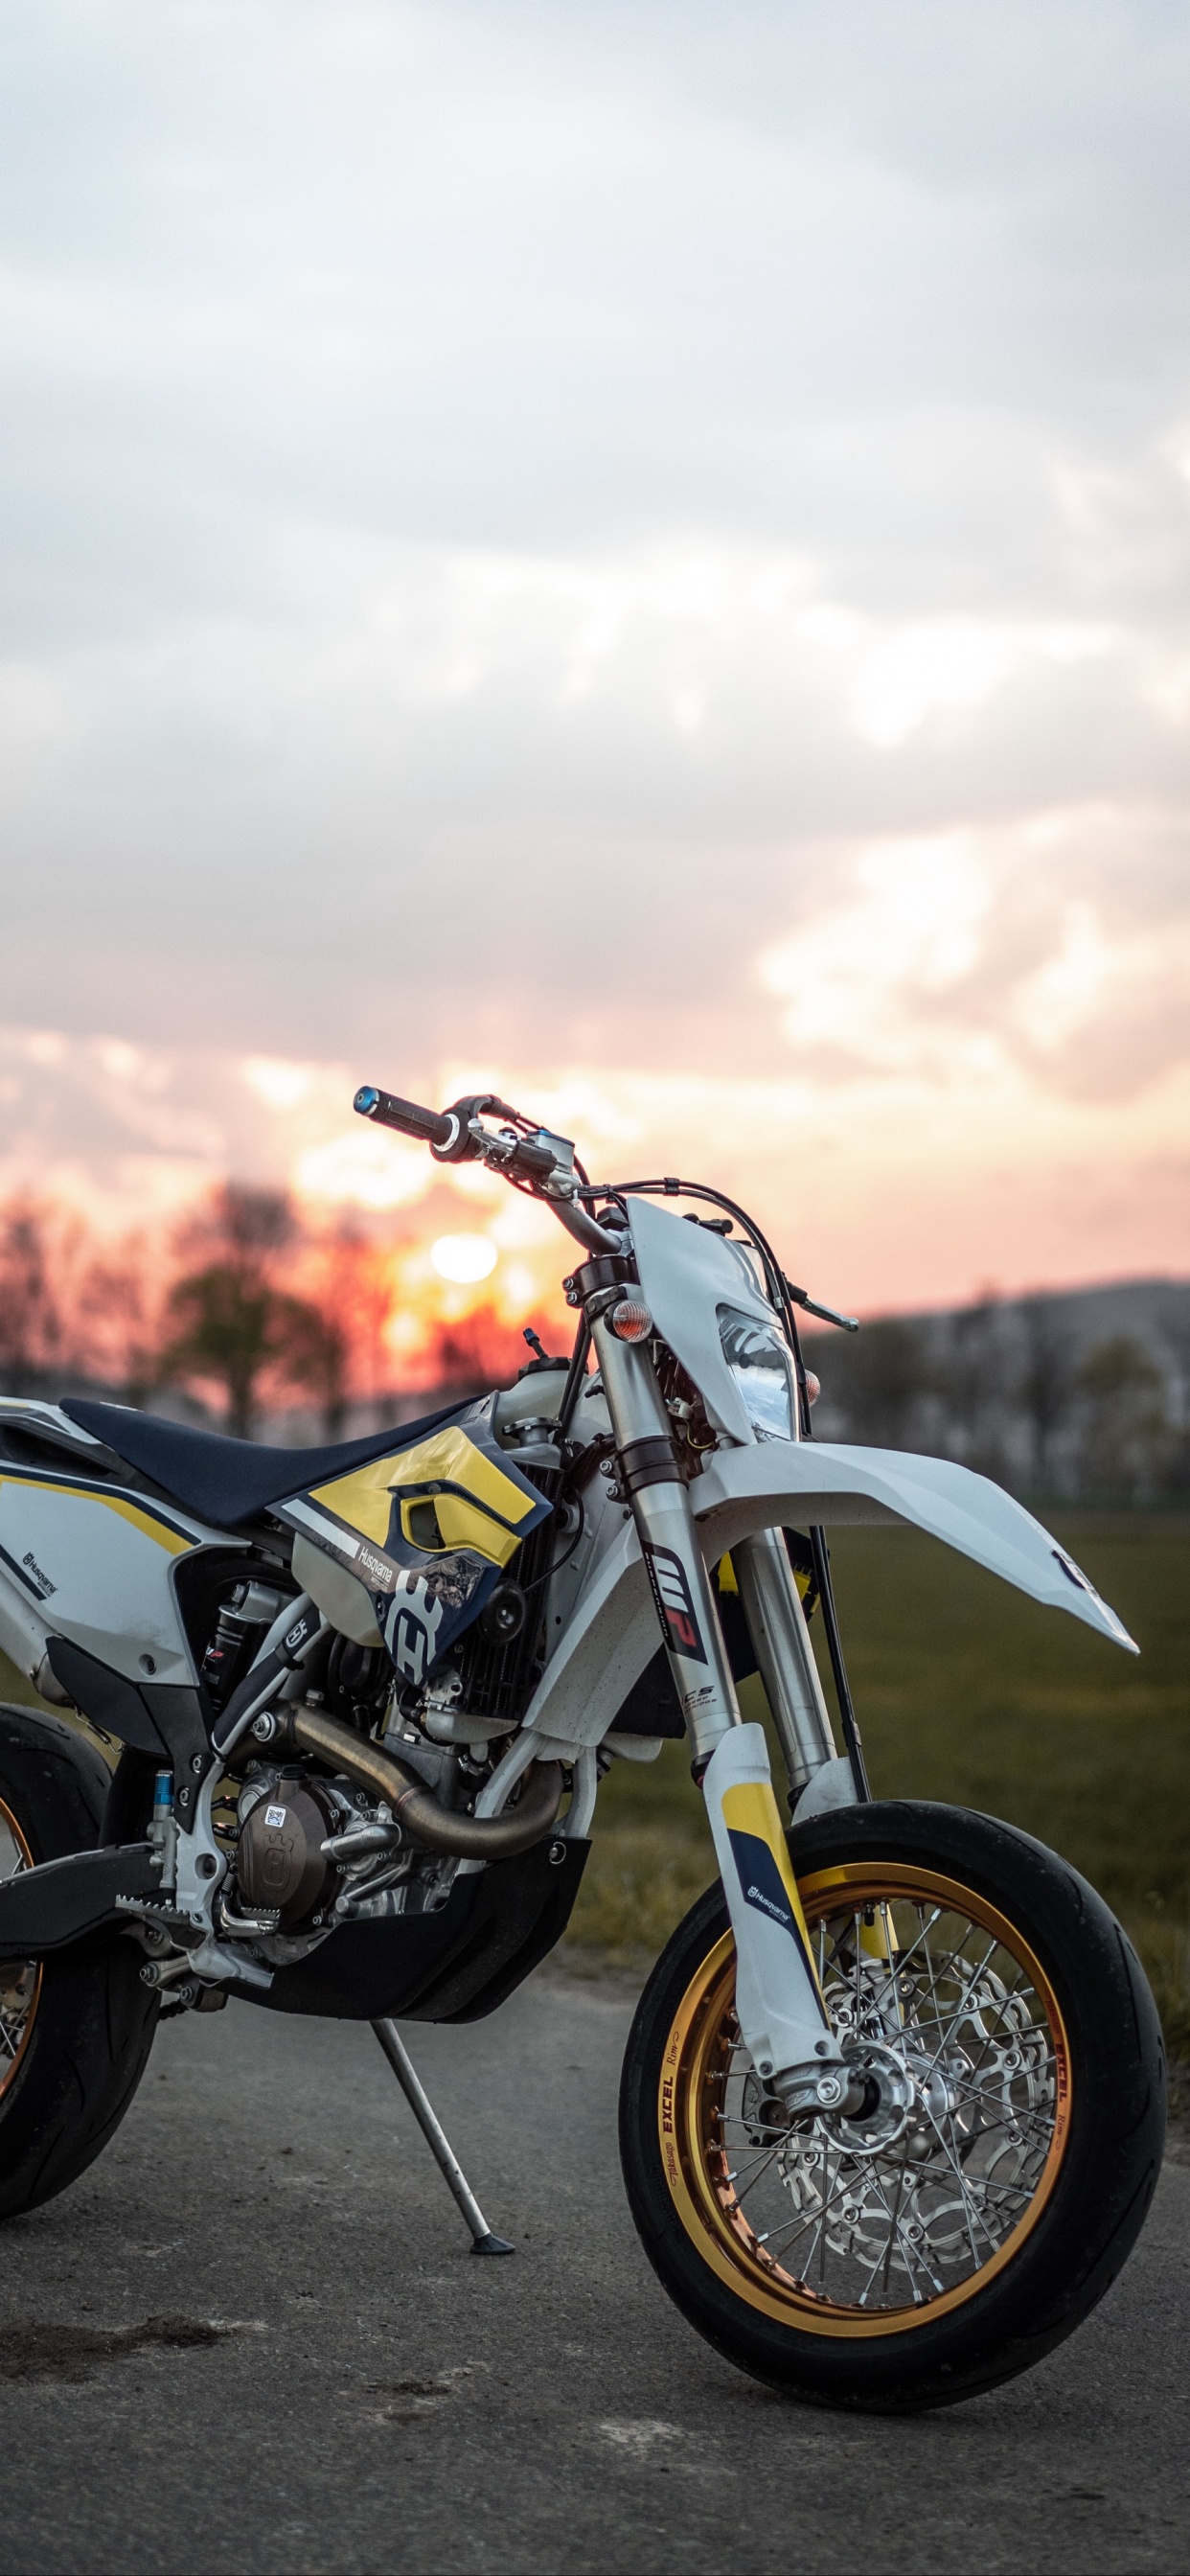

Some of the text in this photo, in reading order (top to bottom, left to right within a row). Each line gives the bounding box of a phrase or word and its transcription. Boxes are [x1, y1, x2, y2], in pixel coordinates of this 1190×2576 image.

[28, 1560, 57, 1594] Husqvarna
[356, 1546, 393, 1583] Husqvarna
[755, 1892, 789, 1920] Husqvarna
[666, 2031, 679, 2065] Rim
[1056, 2043, 1067, 2103] EXCEL
[662, 2076, 674, 2133] EXCEL
[1055, 2114, 1065, 2150] Rim
[665, 2142, 678, 2187] Takasago
